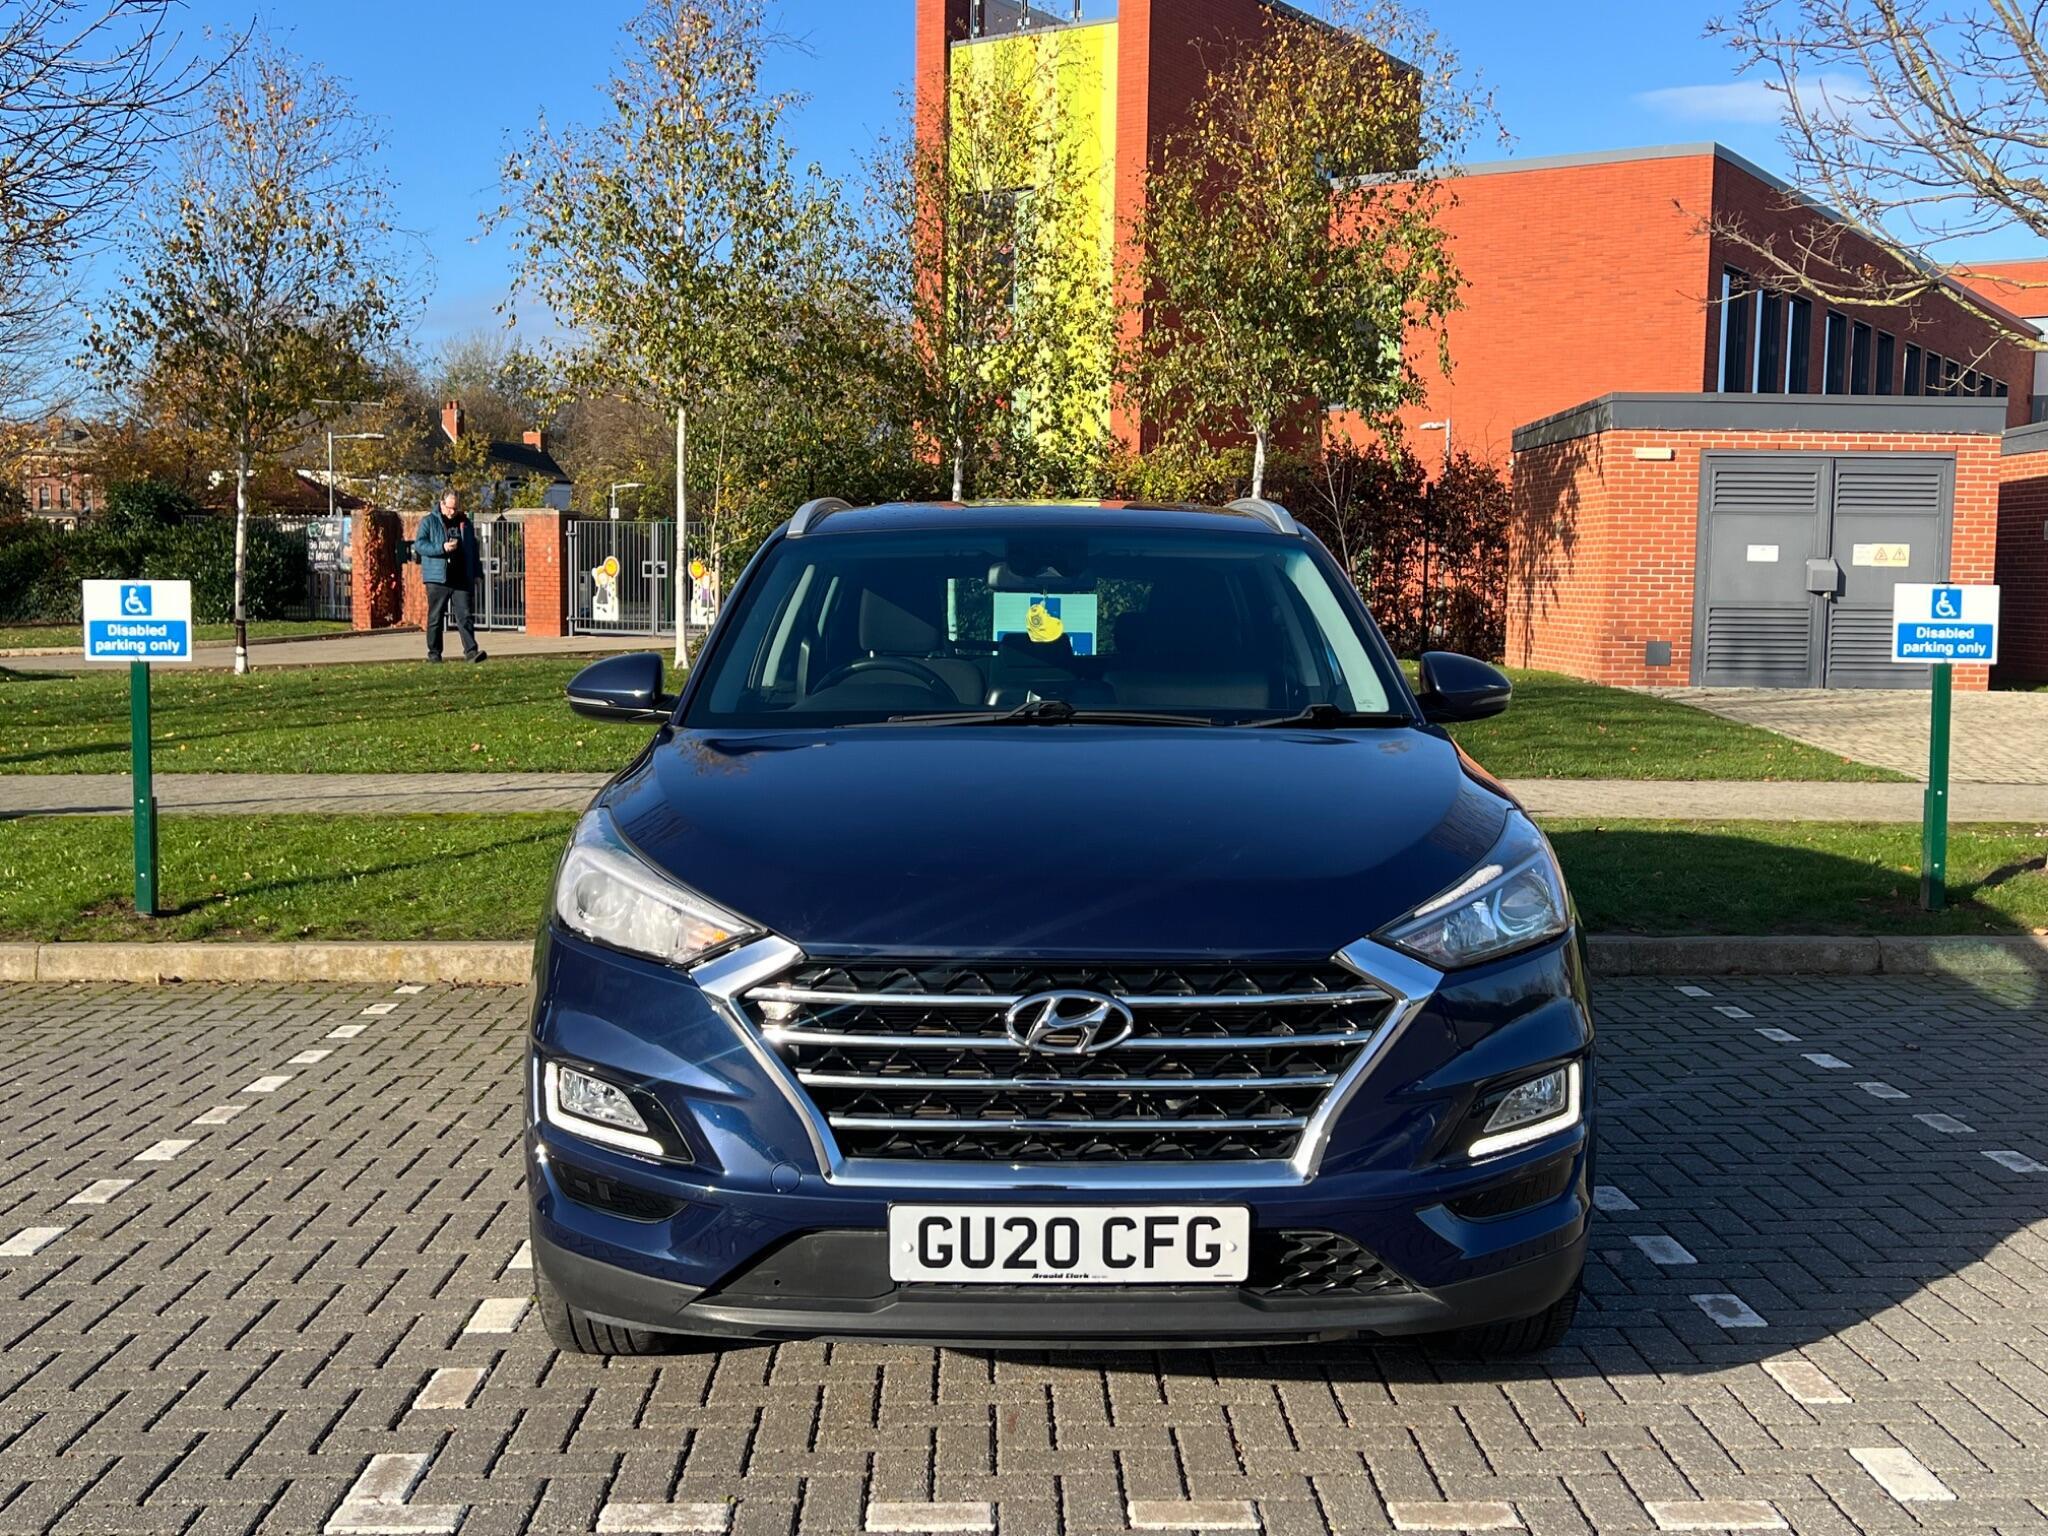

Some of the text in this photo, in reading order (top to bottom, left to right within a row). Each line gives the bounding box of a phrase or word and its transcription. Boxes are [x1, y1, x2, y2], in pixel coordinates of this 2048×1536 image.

[107, 624, 167, 637] Disabled
[1916, 626, 1975, 639] Disabled
[95, 639, 180, 654] parking only
[1903, 641, 1987, 656] parking only
[918, 1215, 1221, 1269] GU20 CFG
